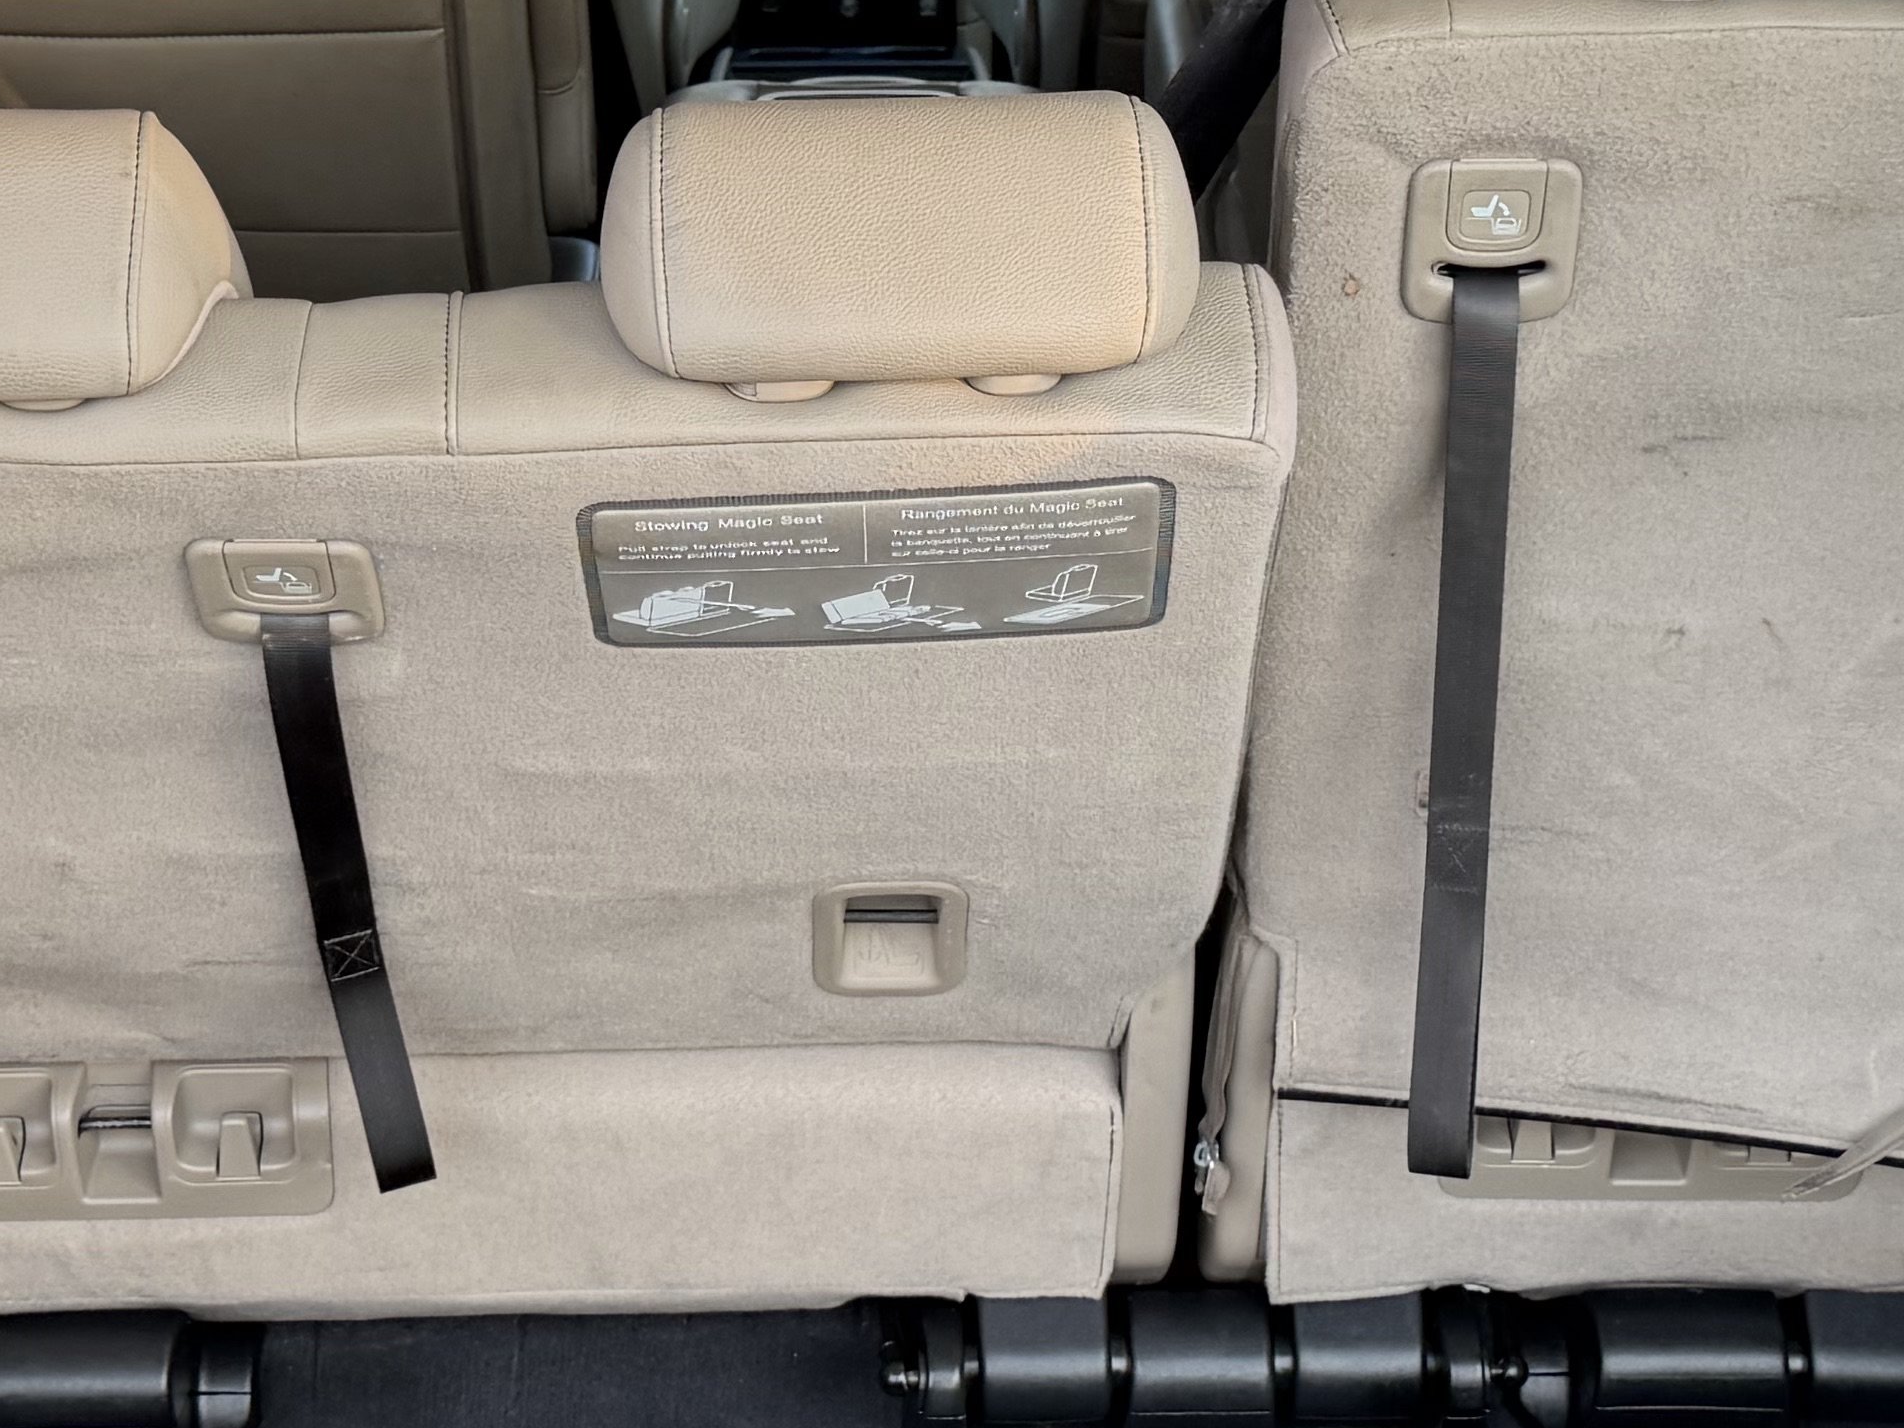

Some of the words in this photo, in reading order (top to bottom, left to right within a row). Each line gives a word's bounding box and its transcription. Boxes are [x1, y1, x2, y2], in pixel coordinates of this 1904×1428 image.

[901, 505, 998, 520] Rangement
[1004, 504, 1025, 515] du
[1029, 501, 1081, 515] Magic
[1085, 497, 1124, 509] Seat
[634, 520, 709, 532] Stowing
[718, 516, 773, 529] Magic
[781, 514, 824, 525] Seat
